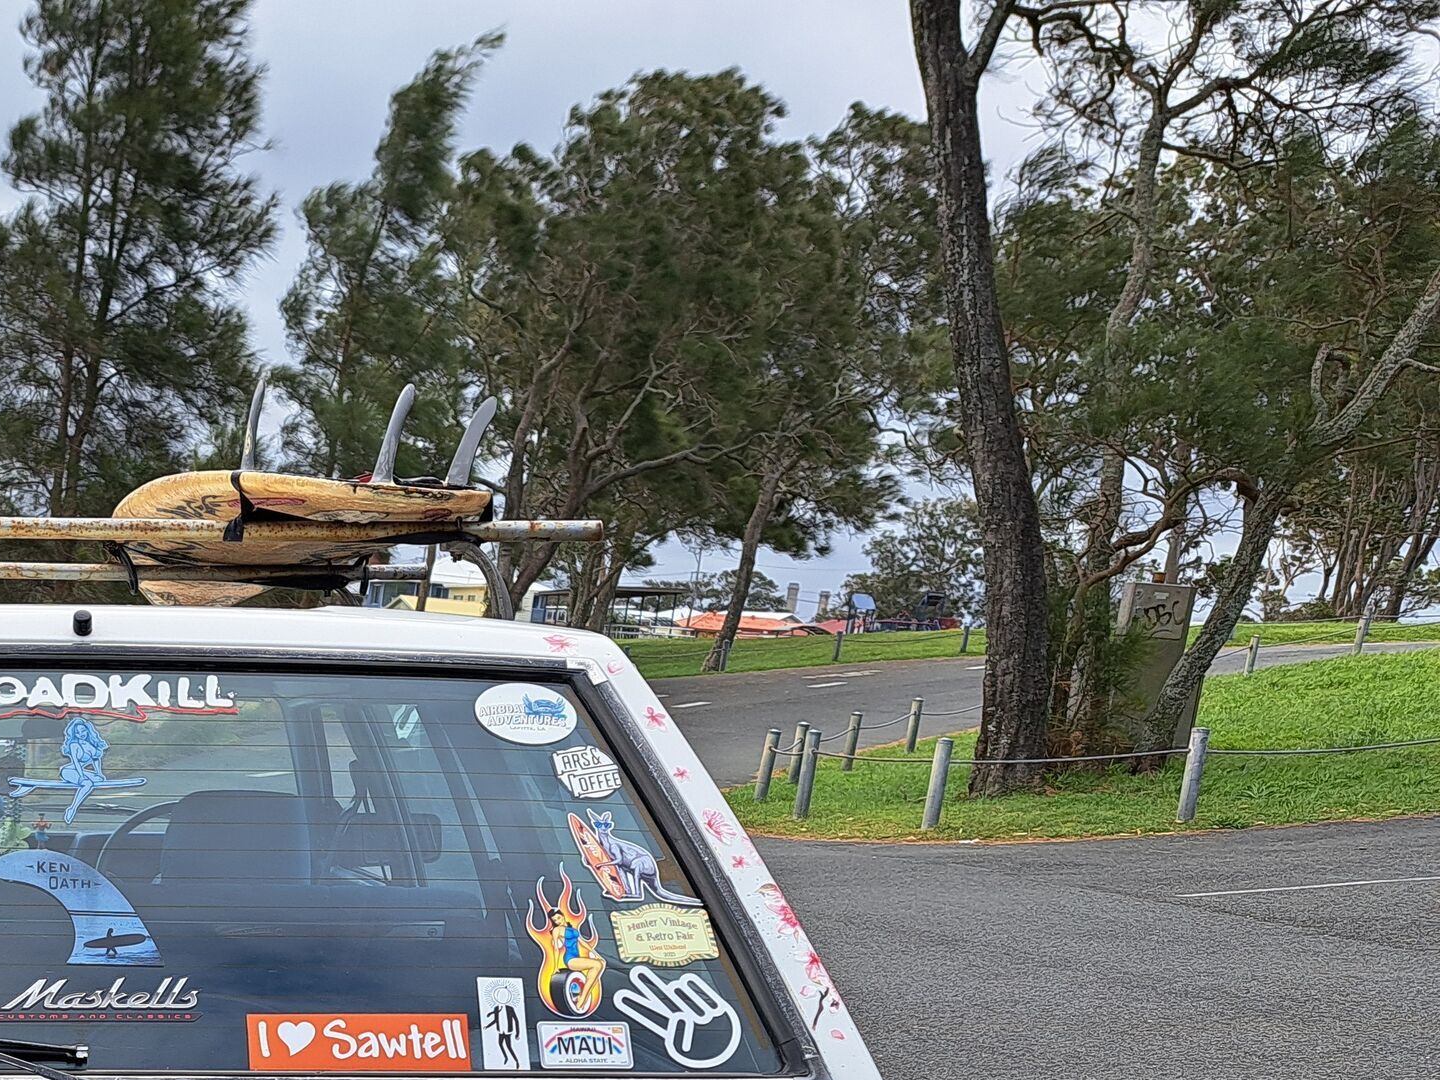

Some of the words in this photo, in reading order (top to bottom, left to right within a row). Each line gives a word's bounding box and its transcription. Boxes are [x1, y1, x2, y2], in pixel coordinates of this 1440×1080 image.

[486, 714, 567, 727] ADVENTURES
[36, 861, 70, 873] KEN
[49, 876, 91, 890] OATH
[2, 977, 199, 1010] Maskells
[258, 1021, 270, 1058] I
[323, 1019, 467, 1060] Sawtell
[557, 1036, 613, 1055] MAUI
